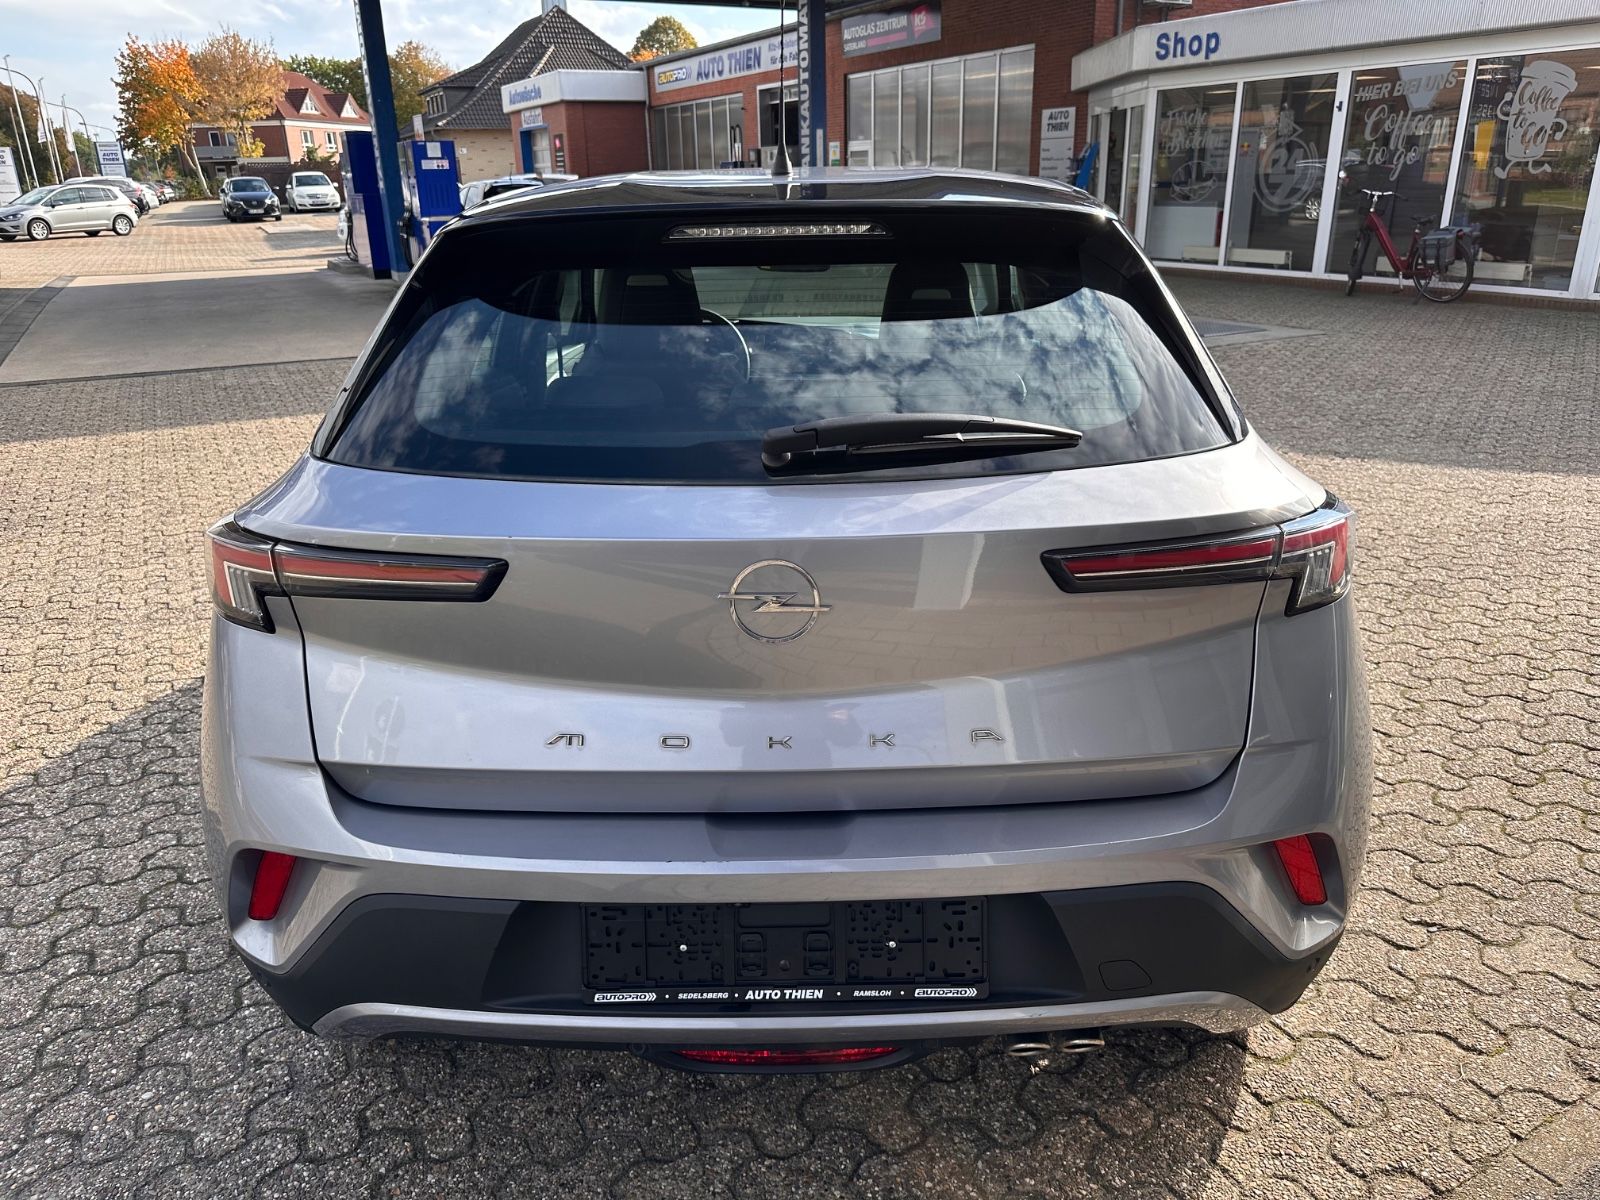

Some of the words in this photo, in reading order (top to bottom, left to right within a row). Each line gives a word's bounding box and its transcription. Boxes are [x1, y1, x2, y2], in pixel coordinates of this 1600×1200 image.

[843, 22, 875, 41] AUTOGLAS
[876, 15, 908, 33] ZENTRUM
[1155, 31, 1220, 61] Shop
[696, 55, 725, 82] AUTO
[727, 45, 762, 75] THIEN
[1354, 82, 1391, 102] HIER
[1393, 78, 1422, 97] BEI
[1424, 71, 1458, 93] UNS
[1047, 121, 1070, 132] THIEN
[1048, 110, 1070, 121] AUTO
[1364, 104, 1434, 150] Coffee
[1366, 142, 1387, 166] to
[1389, 146, 1419, 181] go
[678, 991, 729, 999] SEDELSBERG
[745, 990, 781, 1000] AUTO
[783, 989, 824, 999] THIEN
[853, 989, 892, 997] RAMSLOH
